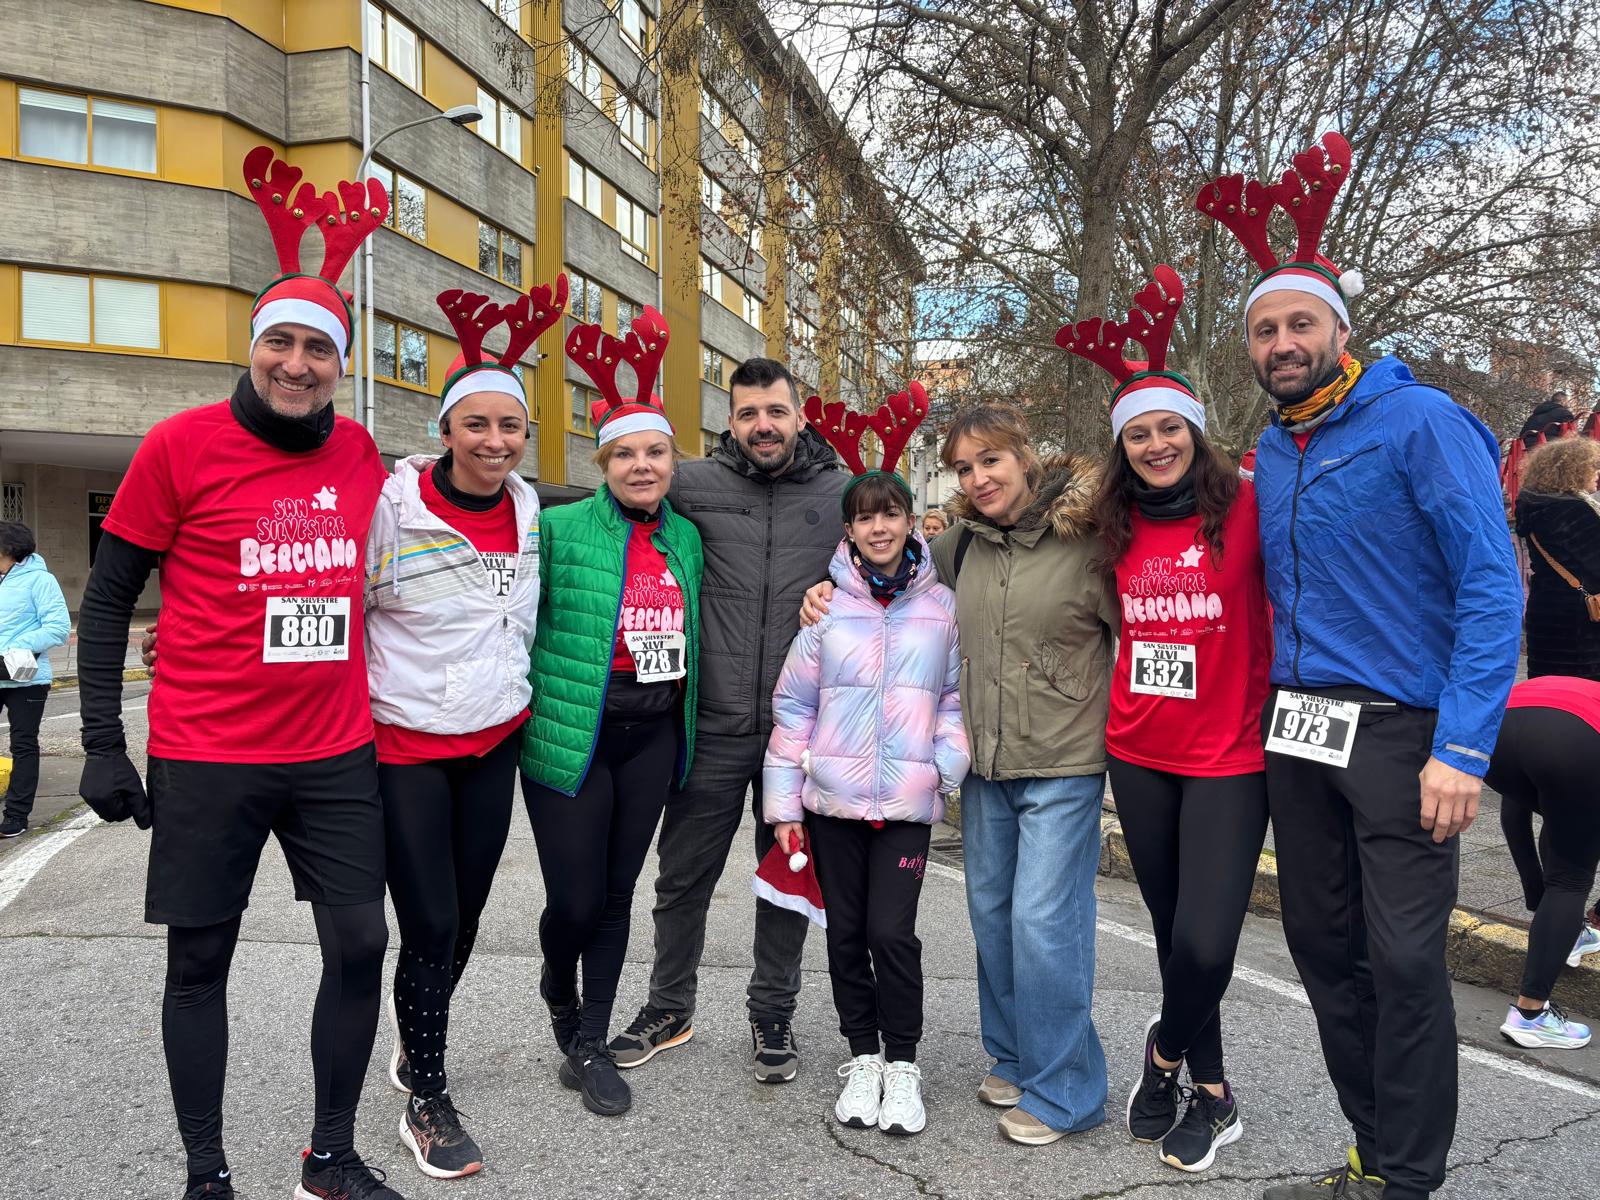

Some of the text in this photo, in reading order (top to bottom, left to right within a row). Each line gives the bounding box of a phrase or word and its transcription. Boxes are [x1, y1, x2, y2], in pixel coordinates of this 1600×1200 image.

[273, 498, 308, 520] SAN
[257, 515, 346, 542] SILVESTRE
[240, 538, 357, 576] BERCIANA
[482, 558, 506, 568] XLVI
[1142, 557, 1171, 578] SAN
[487, 569, 516, 596] 05
[633, 573, 658, 590] SAN
[1128, 572, 1207, 596] SILVESTRE
[296, 604, 326, 614] XLVI
[618, 606, 684, 631] ERCIAN
[1122, 592, 1222, 623] BERCIANA
[281, 616, 335, 646] 880
[642, 641, 664, 650] XLVI
[1153, 650, 1178, 660] XLVI
[635, 650, 671, 674] 228
[1143, 659, 1184, 687] 332
[1299, 701, 1330, 715] XLVI
[1306, 695, 1344, 708] SILVESTRE
[1282, 710, 1330, 745] 973
